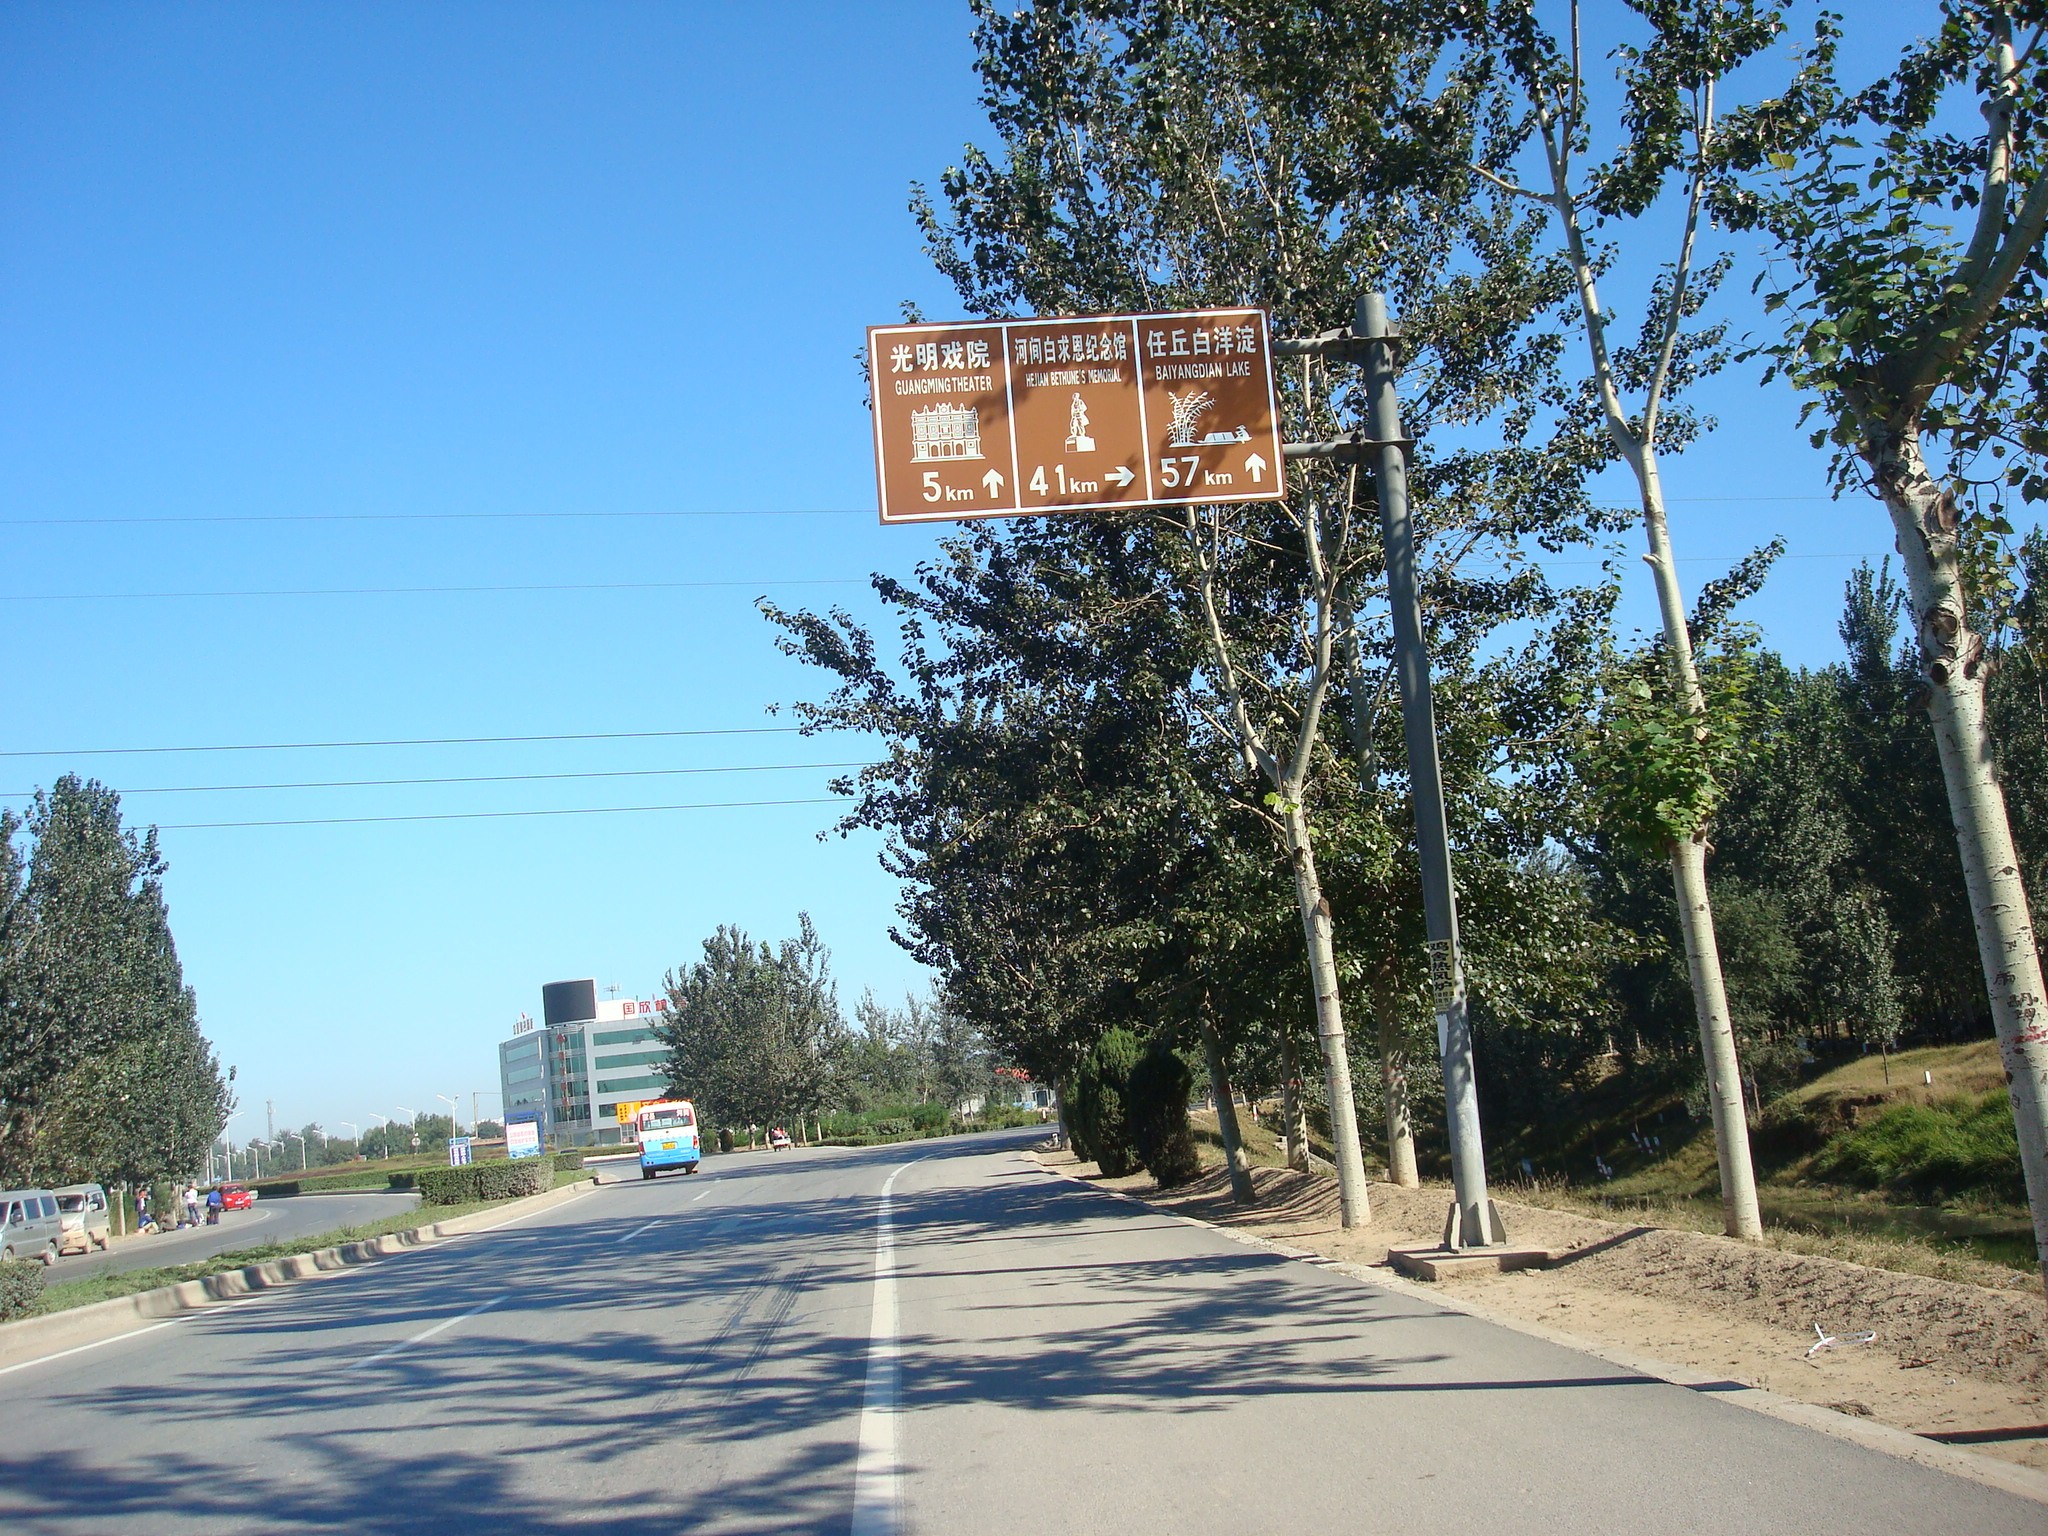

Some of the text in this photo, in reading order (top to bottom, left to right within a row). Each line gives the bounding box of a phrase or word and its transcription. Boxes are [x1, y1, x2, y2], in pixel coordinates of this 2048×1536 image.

[1015, 331, 1127, 366] 河间白求恩纪念馆
[1146, 325, 1257, 359] 任丘白洋淀
[890, 339, 991, 374] 光明戏院
[1025, 367, 1122, 388] HEJIAN BETHUNE'S MEMORIAL
[1155, 361, 1251, 381] BAIYANGDIAN LAKE
[895, 375, 993, 396] GUANGMING THEATER
